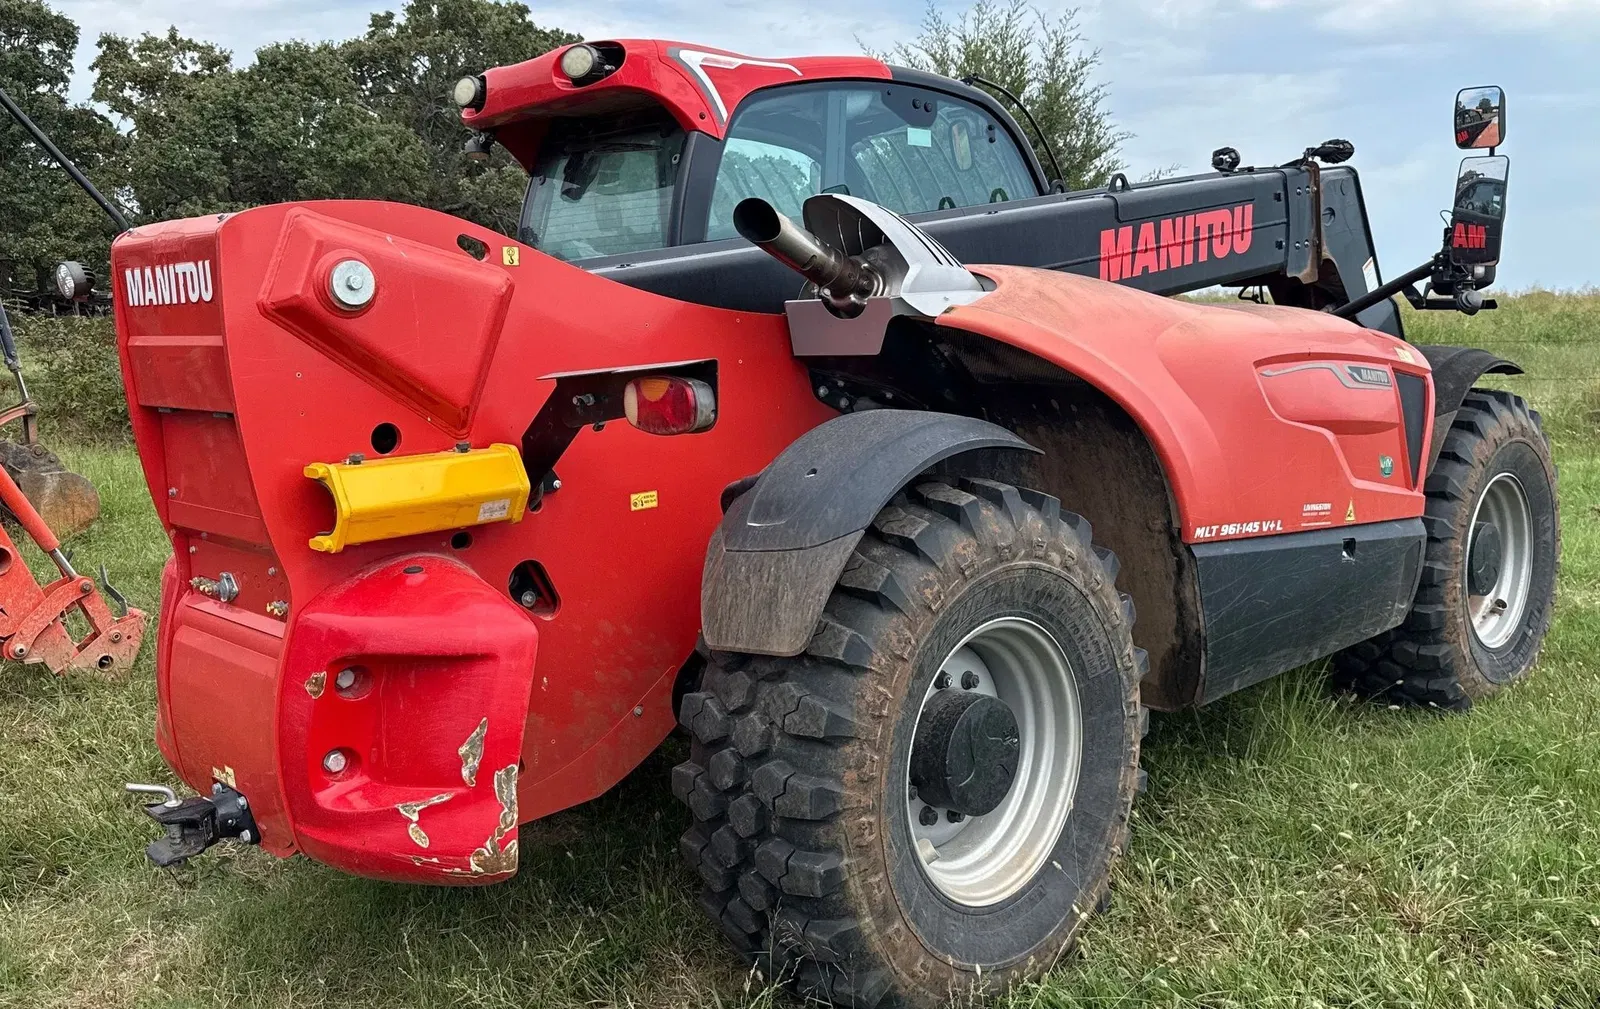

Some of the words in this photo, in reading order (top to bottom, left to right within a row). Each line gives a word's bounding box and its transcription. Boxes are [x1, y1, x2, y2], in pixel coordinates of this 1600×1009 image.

[1100, 203, 1253, 282] MANITOU
[125, 259, 213, 307] MANITOU
[1361, 368, 1388, 383] MANITOU
[1194, 525, 1220, 539] MLT
